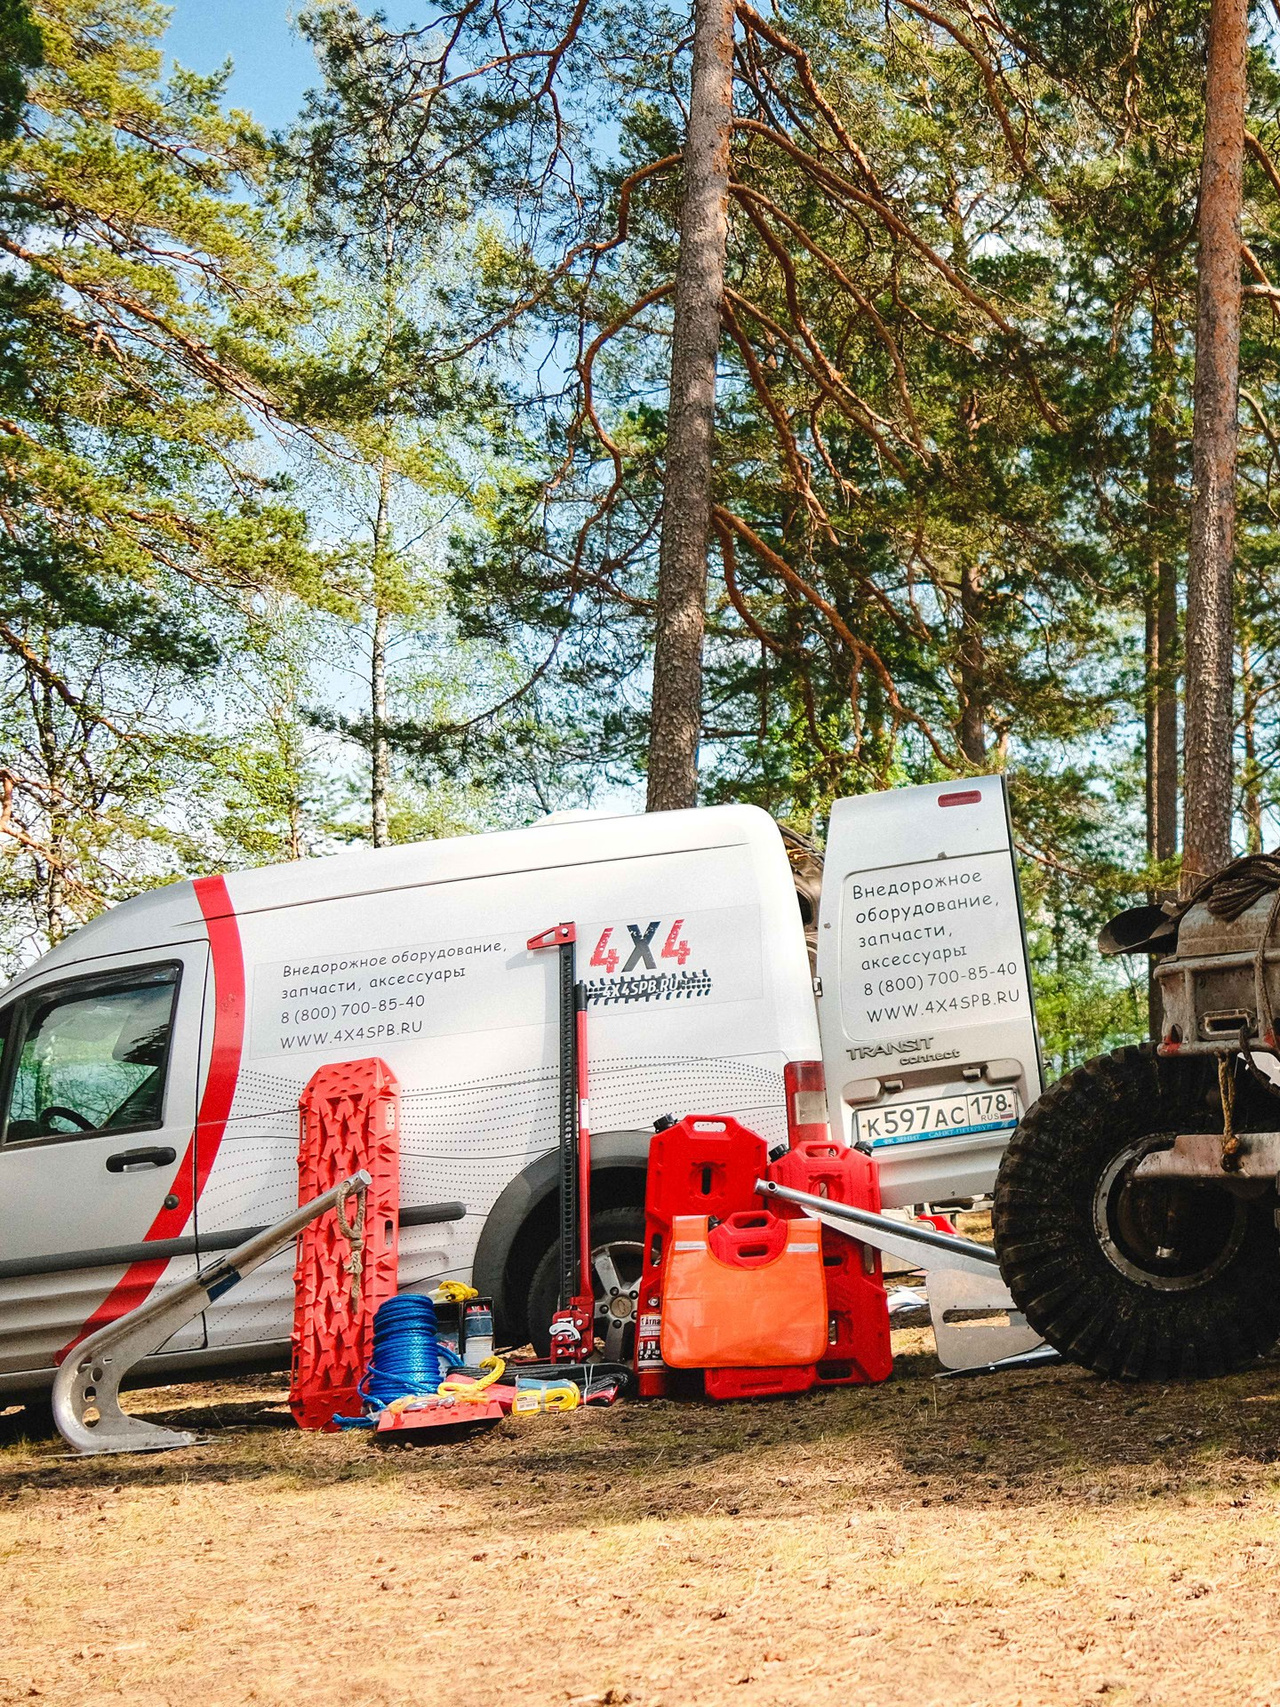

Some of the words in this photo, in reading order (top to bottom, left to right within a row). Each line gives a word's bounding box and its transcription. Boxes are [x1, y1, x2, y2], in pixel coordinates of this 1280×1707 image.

[853, 871, 982, 900] Внедорожное
[855, 894, 999, 924] оборудование,
[589, 919, 691, 974] 4X4
[859, 925, 953, 948] запчасти,
[283, 956, 387, 978] Внедорожное
[391, 940, 507, 963] оборудование,
[861, 946, 967, 971] аксессуары
[281, 981, 362, 999] запчасти,
[369, 966, 466, 988] аксессуары
[603, 978, 678, 998] 4X4SPB.RU
[864, 982, 873, 996] 8
[878, 974, 923, 996] (800)
[927, 961, 1018, 986] 700-85-40
[281, 1011, 290, 1025] 8
[294, 1005, 337, 1025] (800)
[341, 994, 425, 1017] 700-85-40
[866, 989, 1020, 1023] WWW.4X4SPB.RU
[280, 1021, 423, 1049] WWW.4X4SPB.RU
[846, 1037, 934, 1061] TRANSIT
[900, 1049, 961, 1066] connect
[970, 1094, 1008, 1115] 178
[980, 1112, 1000, 1122] RUS
